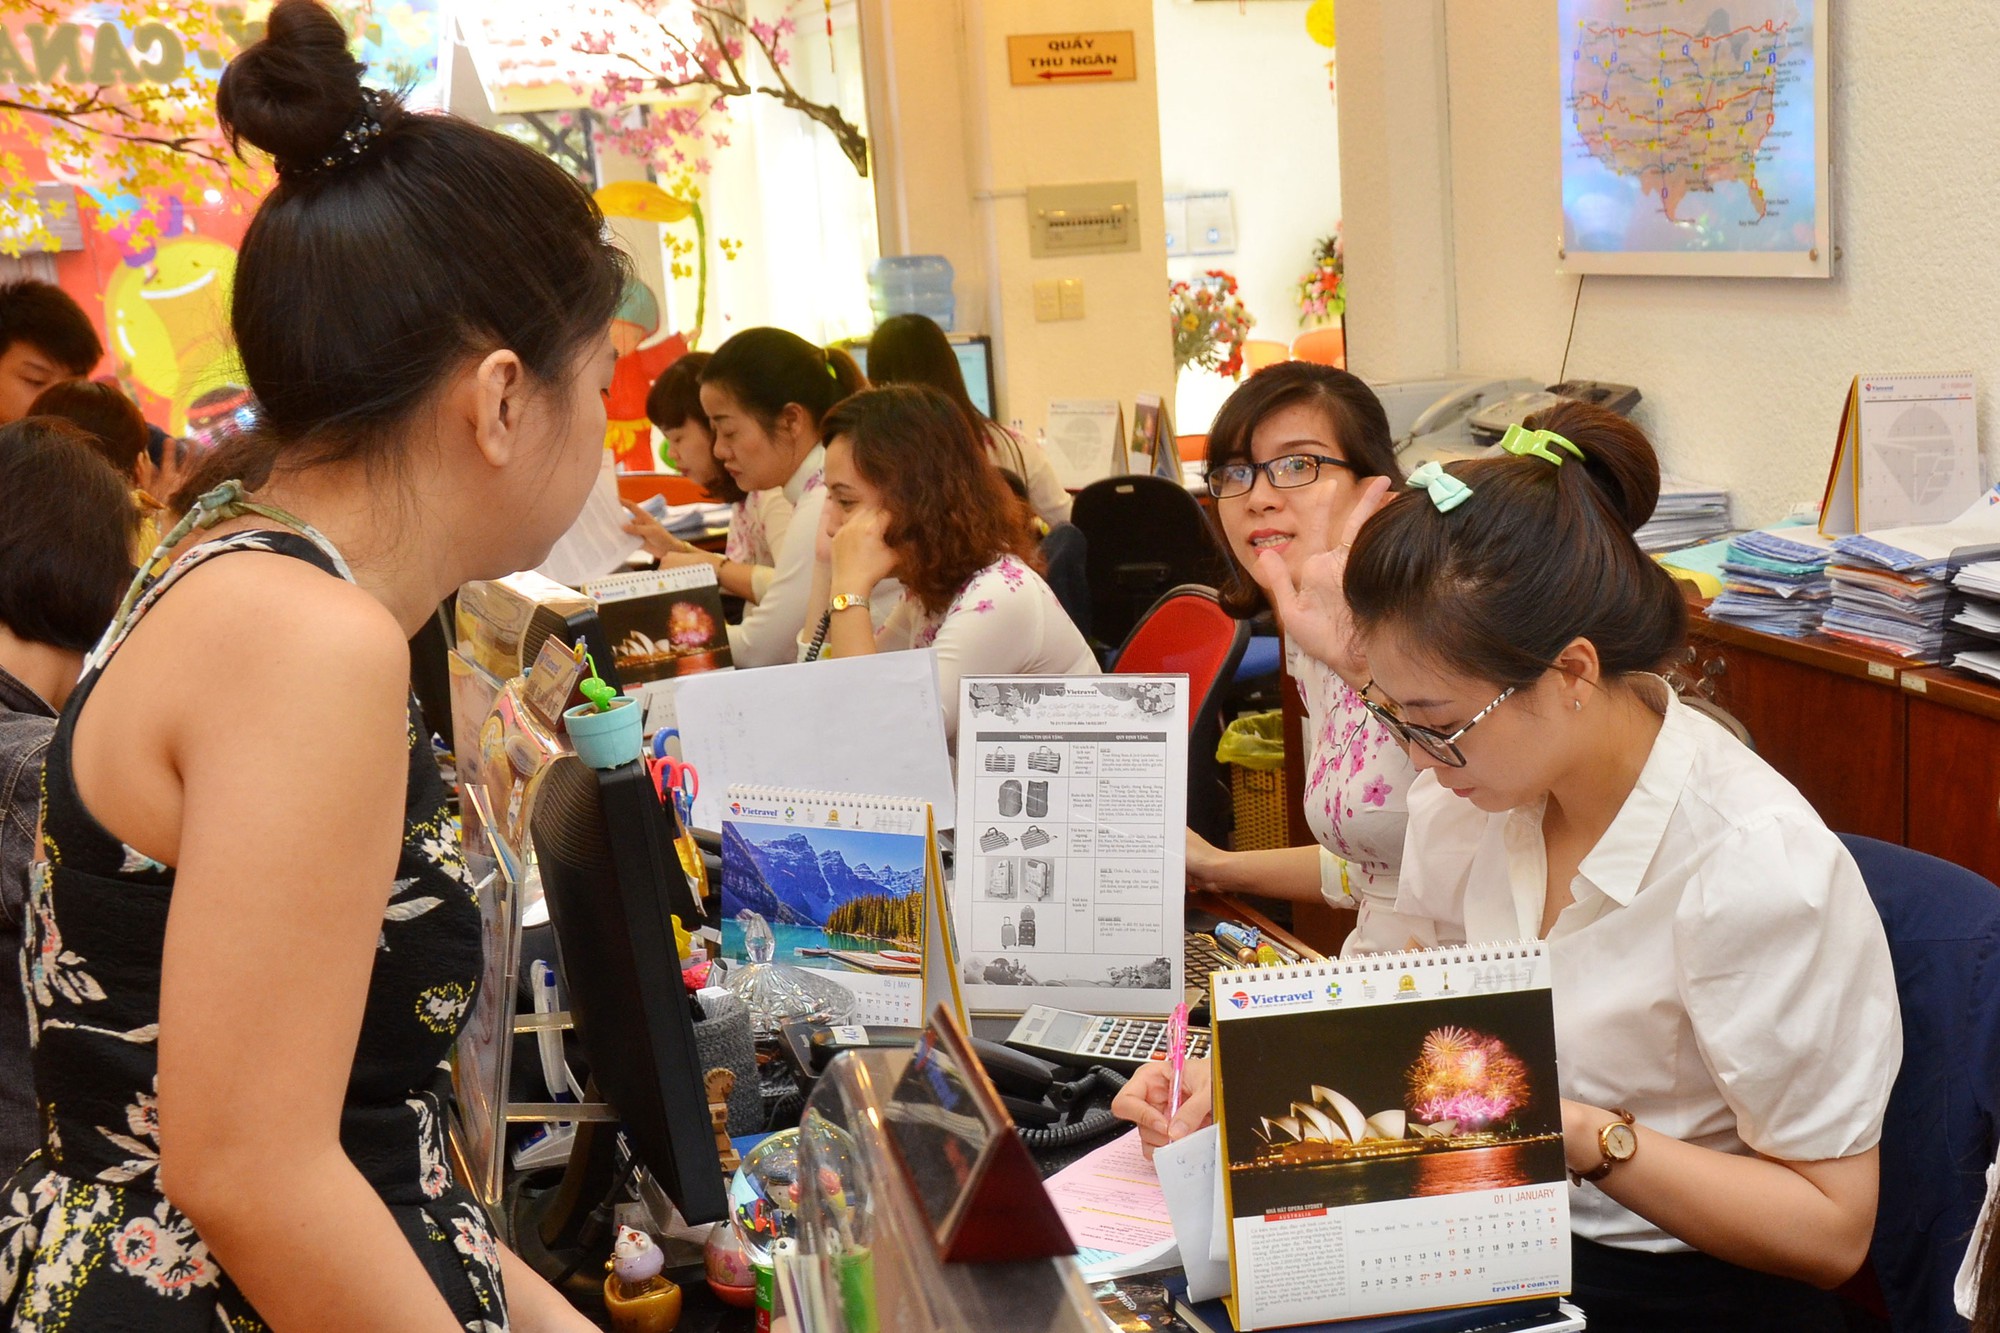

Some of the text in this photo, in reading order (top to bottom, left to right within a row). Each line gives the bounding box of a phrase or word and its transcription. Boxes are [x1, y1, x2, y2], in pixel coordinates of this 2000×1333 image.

[1029, 53, 1117, 67] THU NGÂN
[742, 807, 778, 817] Vietravel
[1251, 990, 1313, 1004] Vietravel
[1494, 1188, 1555, 1204] 01 JANUARY
